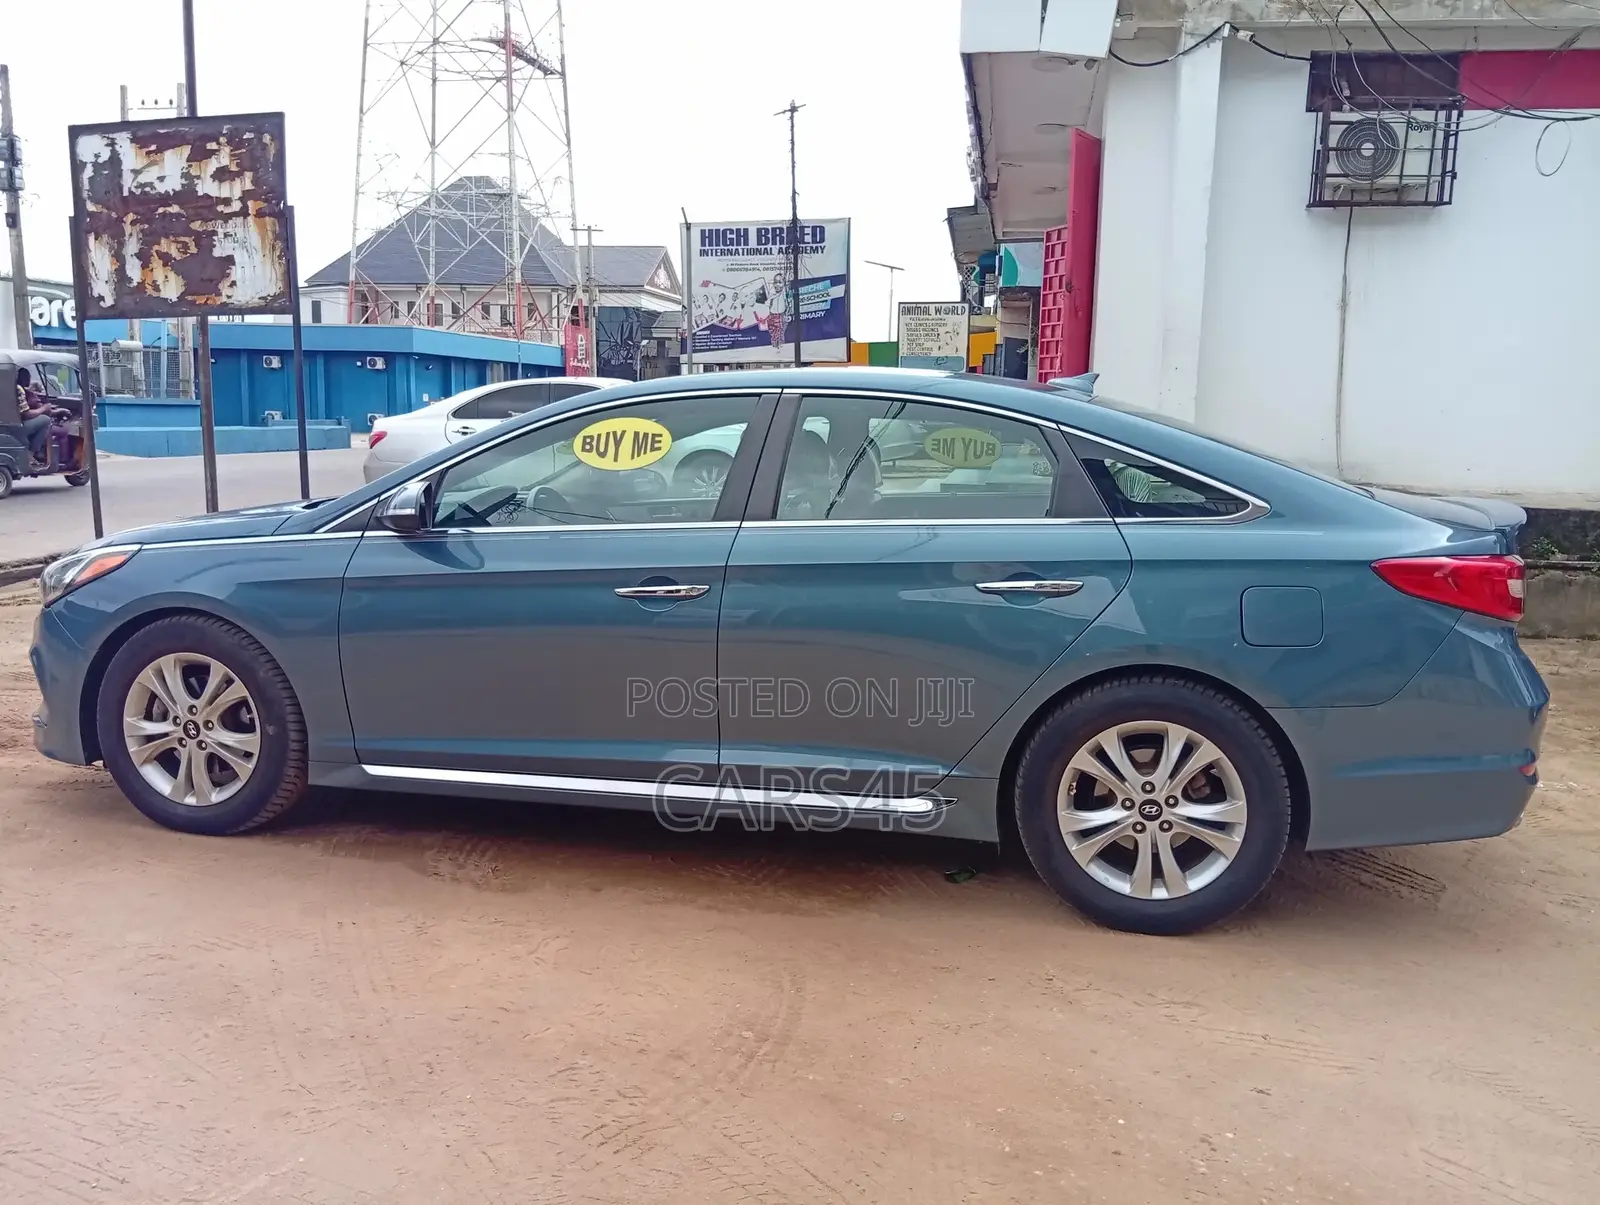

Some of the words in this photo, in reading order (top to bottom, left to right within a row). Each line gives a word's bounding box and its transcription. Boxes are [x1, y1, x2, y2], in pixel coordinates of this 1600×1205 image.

[700, 227, 749, 247] HIGH
[699, 246, 775, 257] INTERNATIONAL
[777, 245, 826, 256] ACDEMY
[793, 283, 824, 294] RECHE
[28, 296, 77, 329] are
[793, 310, 826, 321] RIMARY
[901, 304, 932, 316] ANIMAL
[581, 430, 627, 463] BUY
[631, 431, 663, 460] ME
